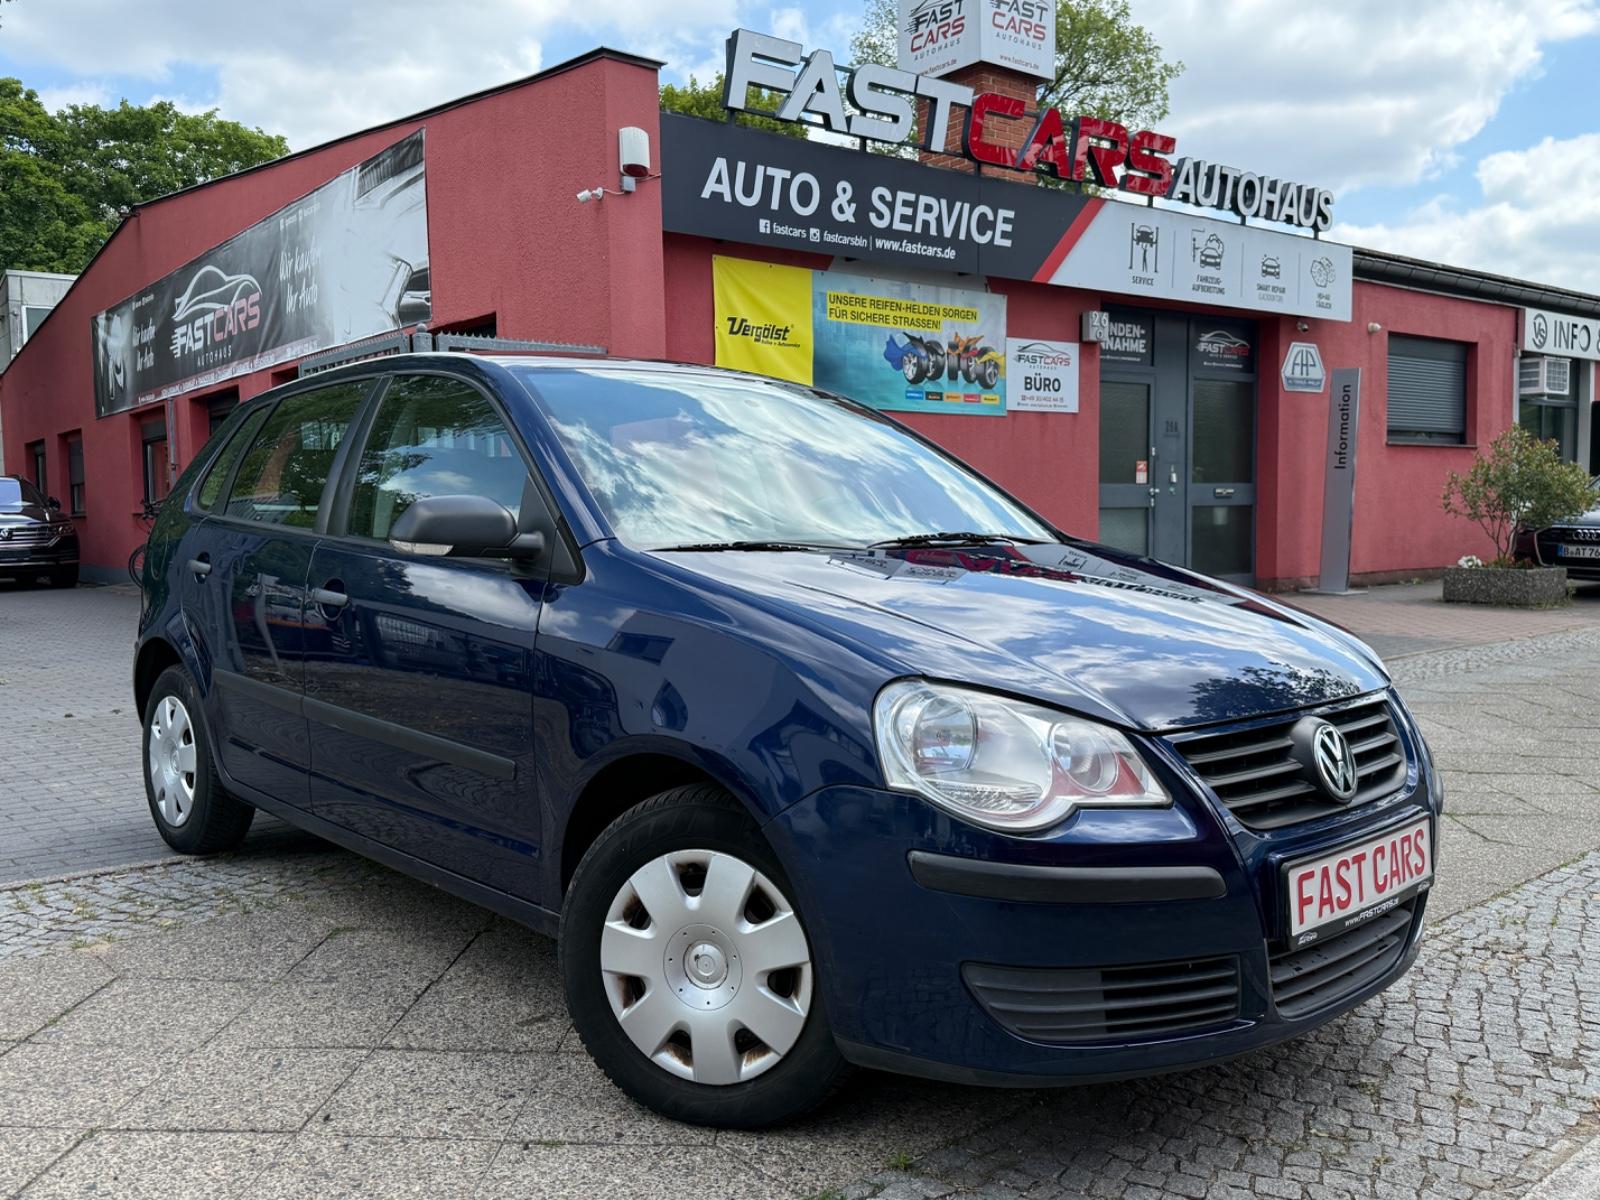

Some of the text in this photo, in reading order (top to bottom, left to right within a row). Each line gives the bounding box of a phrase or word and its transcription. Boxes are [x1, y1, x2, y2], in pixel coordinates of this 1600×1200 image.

[910, 15, 965, 52] CARS
[992, 11, 1046, 41] CARS
[914, 37, 960, 61] AUTOHAUS
[995, 31, 1042, 50] AUTOHAUS
[701, 157, 1015, 248] AUTO & SERVICE
[1172, 156, 1335, 232] AUTOHAUS
[773, 223, 807, 239] fastcars
[875, 238, 957, 260] www.fastcars.de
[828, 294, 977, 320] UNSERE REIFEN-HELDEN SORGEN
[829, 307, 941, 330] FÜR SICHERE STRASSEN!
[1092, 310, 1108, 327] 26
[727, 317, 790, 343] Vergölst
[1108, 322, 1145, 338] NDEN-
[1553, 319, 1591, 352] INFO
[197, 345, 232, 367] AUTOHAUS
[1024, 372, 1061, 392] BÜRO
[1334, 385, 1351, 469] Information
[1297, 828, 1426, 925] FAST CARS
